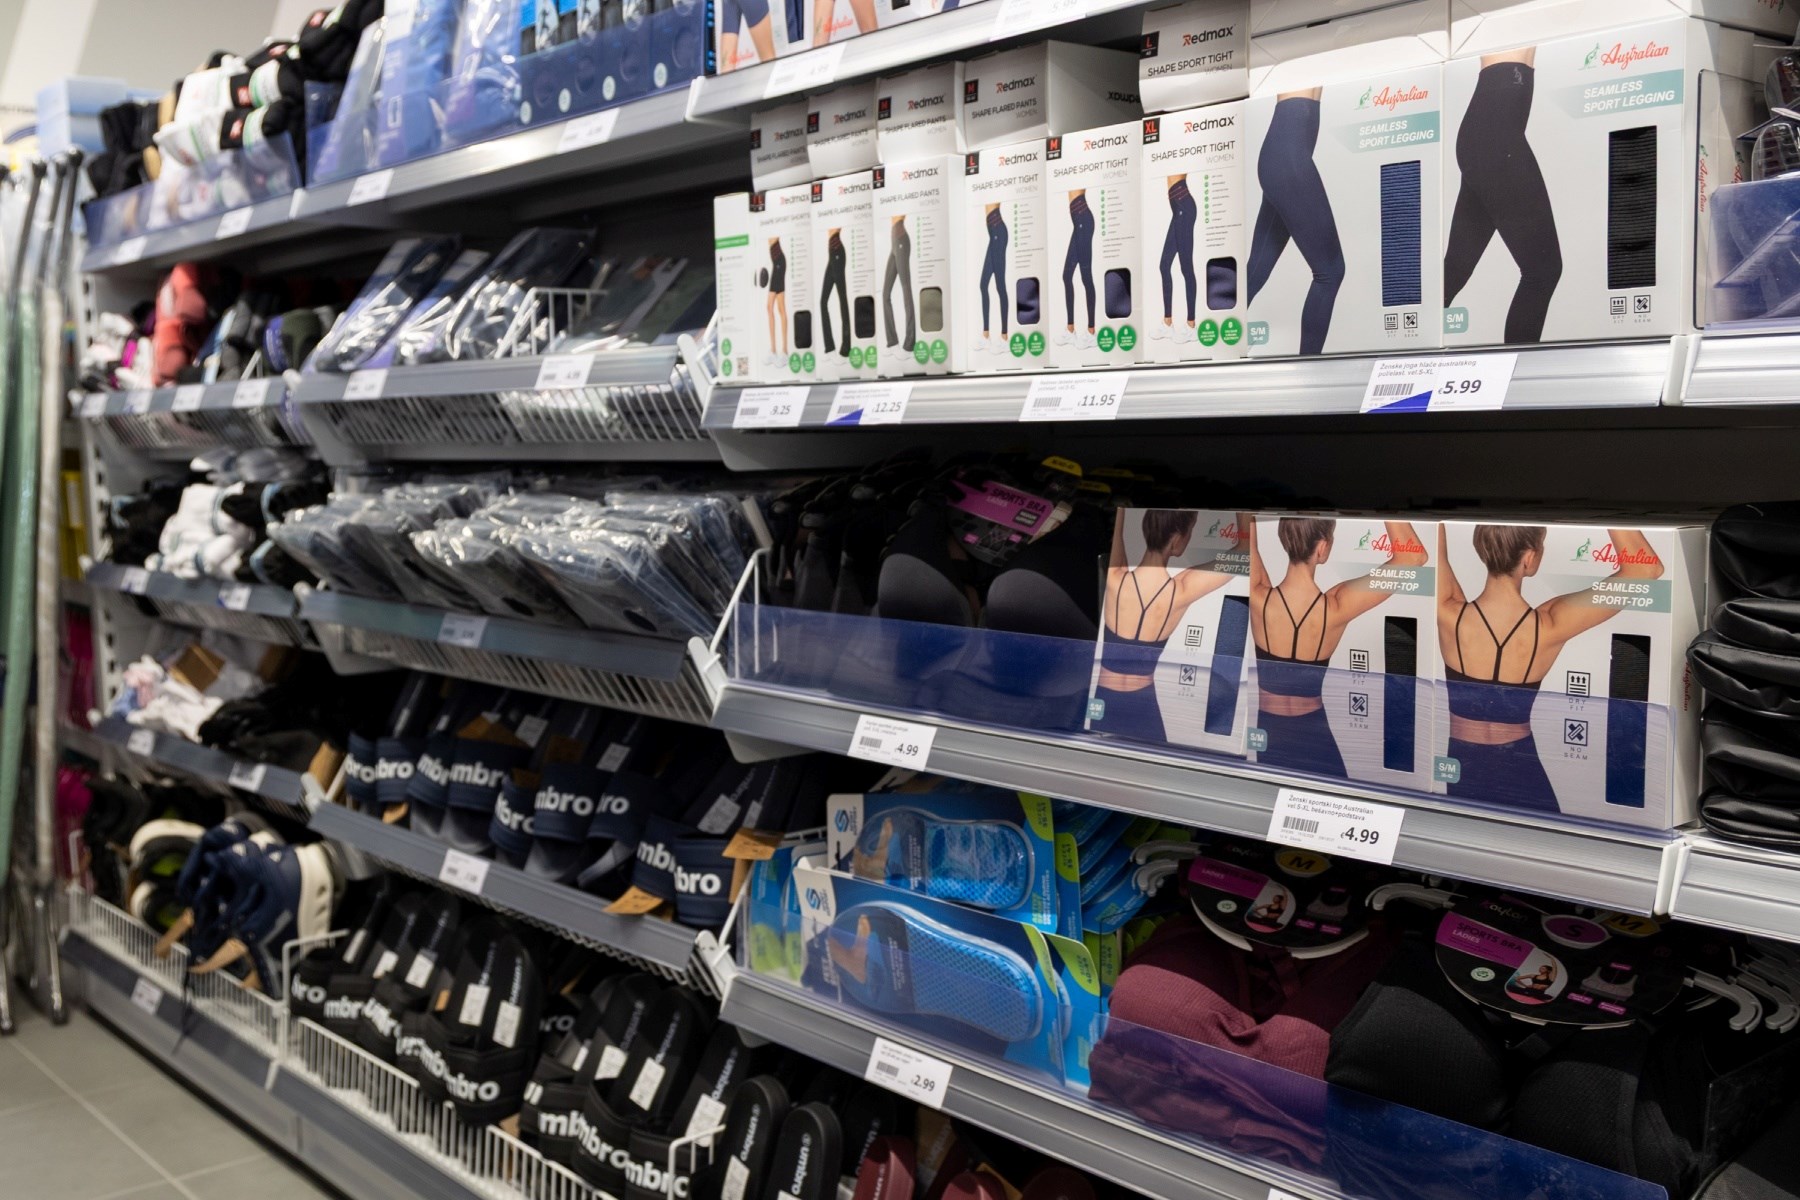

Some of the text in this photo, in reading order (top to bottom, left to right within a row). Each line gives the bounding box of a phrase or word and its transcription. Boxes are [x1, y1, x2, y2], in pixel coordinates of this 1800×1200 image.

[1145, 37, 1153, 48] L
[1183, 26, 1234, 47] Redmax
[1601, 41, 1669, 70] Australian
[1148, 51, 1234, 77] SHAPE SPORT TIGHT
[1205, 63, 1233, 76] WOMEN
[966, 83, 975, 93] M
[996, 76, 1035, 94] Redmax
[1584, 80, 1643, 99] SEAMLESS
[907, 95, 945, 110] Redmax
[1373, 85, 1428, 112] Australian
[1583, 90, 1675, 113] SPORT LEGGING
[972, 98, 1037, 119] SHAPE FLARED PANTS
[834, 109, 867, 125] Redmax
[885, 115, 947, 134] SHAPE FLARED PANTS
[1184, 115, 1235, 133] Redmax
[774, 126, 804, 142] Redmax
[1145, 121, 1157, 133] XL
[1360, 120, 1408, 136] SEAMLESS
[1049, 140, 1058, 150] M
[1084, 135, 1128, 151] Redmax
[1359, 129, 1434, 149] SPORT LEGGING
[1151, 140, 1236, 162] SHAPE SPORT TIGHT
[969, 155, 976, 165] L
[998, 151, 1038, 167] Redmax
[1206, 153, 1234, 165] WOMEN
[874, 168, 882, 180] L
[902, 167, 939, 181] Redmax
[1053, 157, 1129, 177] SHAPE SPORT TIGHT
[1102, 168, 1128, 179] WOMEN
[838, 182, 871, 195] Redmax
[971, 173, 1039, 192] SHAPE SPORT TIGHT
[1015, 183, 1038, 193] WOMEN
[780, 192, 810, 205] Redmax
[880, 188, 940, 205] SHAPE FLARED PANTS
[817, 208, 835, 218] SHAPE
[853, 202, 873, 213] PANTS
[1446, 313, 1464, 323] S/M
[1250, 326, 1266, 336] S/M
[1403, 362, 1418, 370] joga
[1419, 360, 1436, 368] hlače
[1437, 379, 1482, 395] €5.99
[770, 404, 791, 416] 9.25
[872, 401, 902, 413] 12.25
[990, 488, 1047, 513] SPORTS BRA
[1215, 552, 1250, 562] SEAMLES
[1592, 543, 1659, 570] Australian
[1213, 563, 1250, 573] SPORT-TO
[1369, 568, 1417, 579] SEAMLESS
[1369, 580, 1420, 591] SPORT-TOP
[1592, 581, 1650, 594] SEAMLESS
[1592, 595, 1654, 608] SPORT-TOP
[1089, 703, 1103, 712] S/M
[1568, 698, 1587, 706] DRY
[1250, 732, 1265, 743] S/M
[1563, 752, 1588, 761] SEAM
[1438, 762, 1456, 773] S/M
[1288, 794, 1374, 815] Ženski sportski top Australian
[1340, 826, 1380, 845] €4.99
[1288, 855, 1316, 870] M
[1611, 913, 1645, 931] M
[1452, 929, 1481, 944] LADIES
[1456, 921, 1522, 952] SPORTS BRA
[1567, 924, 1583, 939] S
[740, 1110, 759, 1161] umbro
[791, 1144, 811, 1195] umbro
